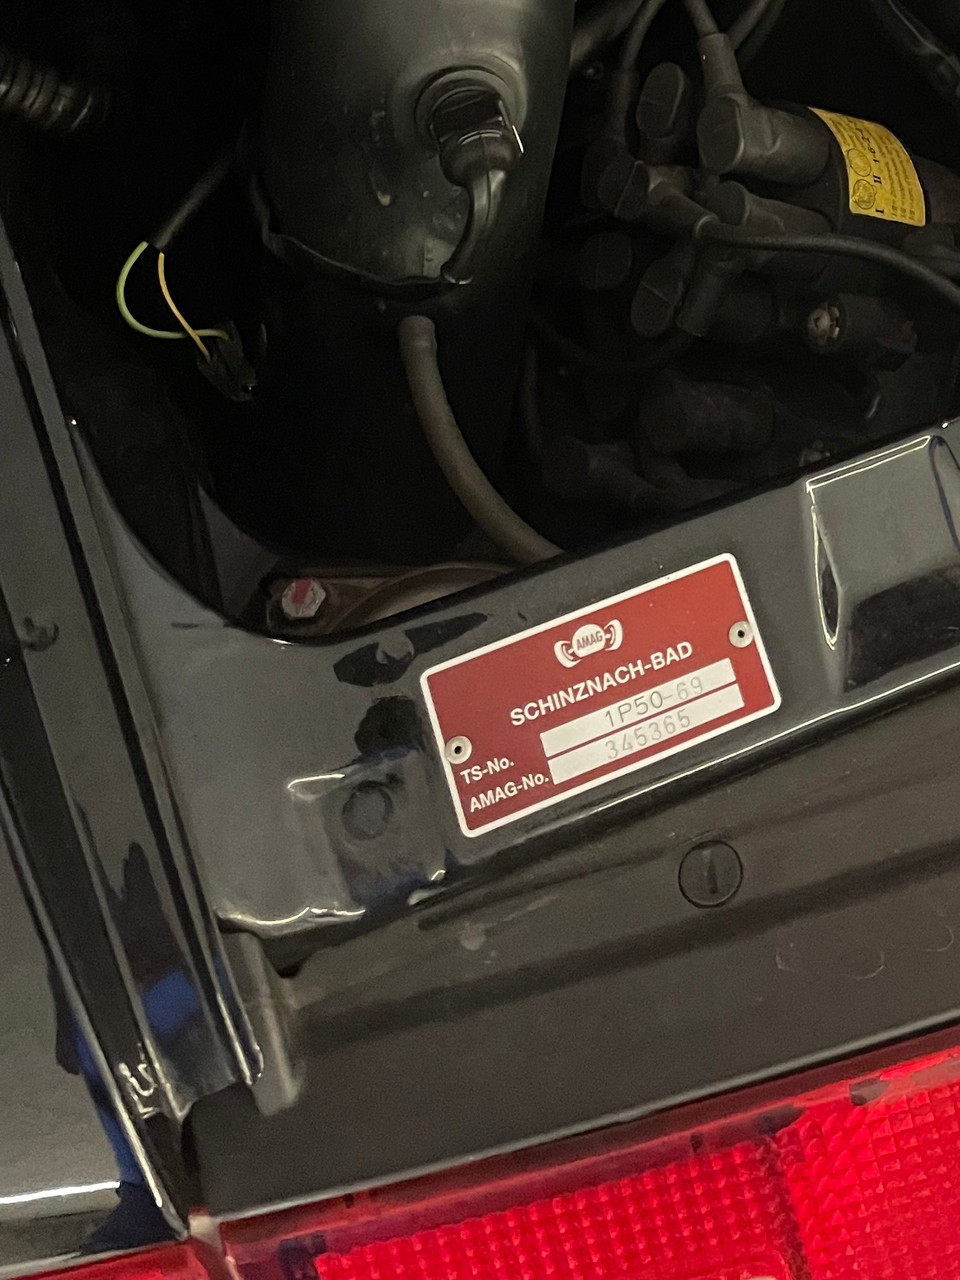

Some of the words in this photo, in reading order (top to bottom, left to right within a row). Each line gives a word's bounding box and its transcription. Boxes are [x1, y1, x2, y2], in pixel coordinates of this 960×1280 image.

[510, 641, 694, 727] SCHINZNACH-BAD
[576, 631, 604, 651] AMAG
[460, 757, 516, 785] TS-No.
[604, 676, 704, 728] 1P50-69
[469, 773, 549, 813] AMAG-No.
[604, 708, 692, 761] 345365
